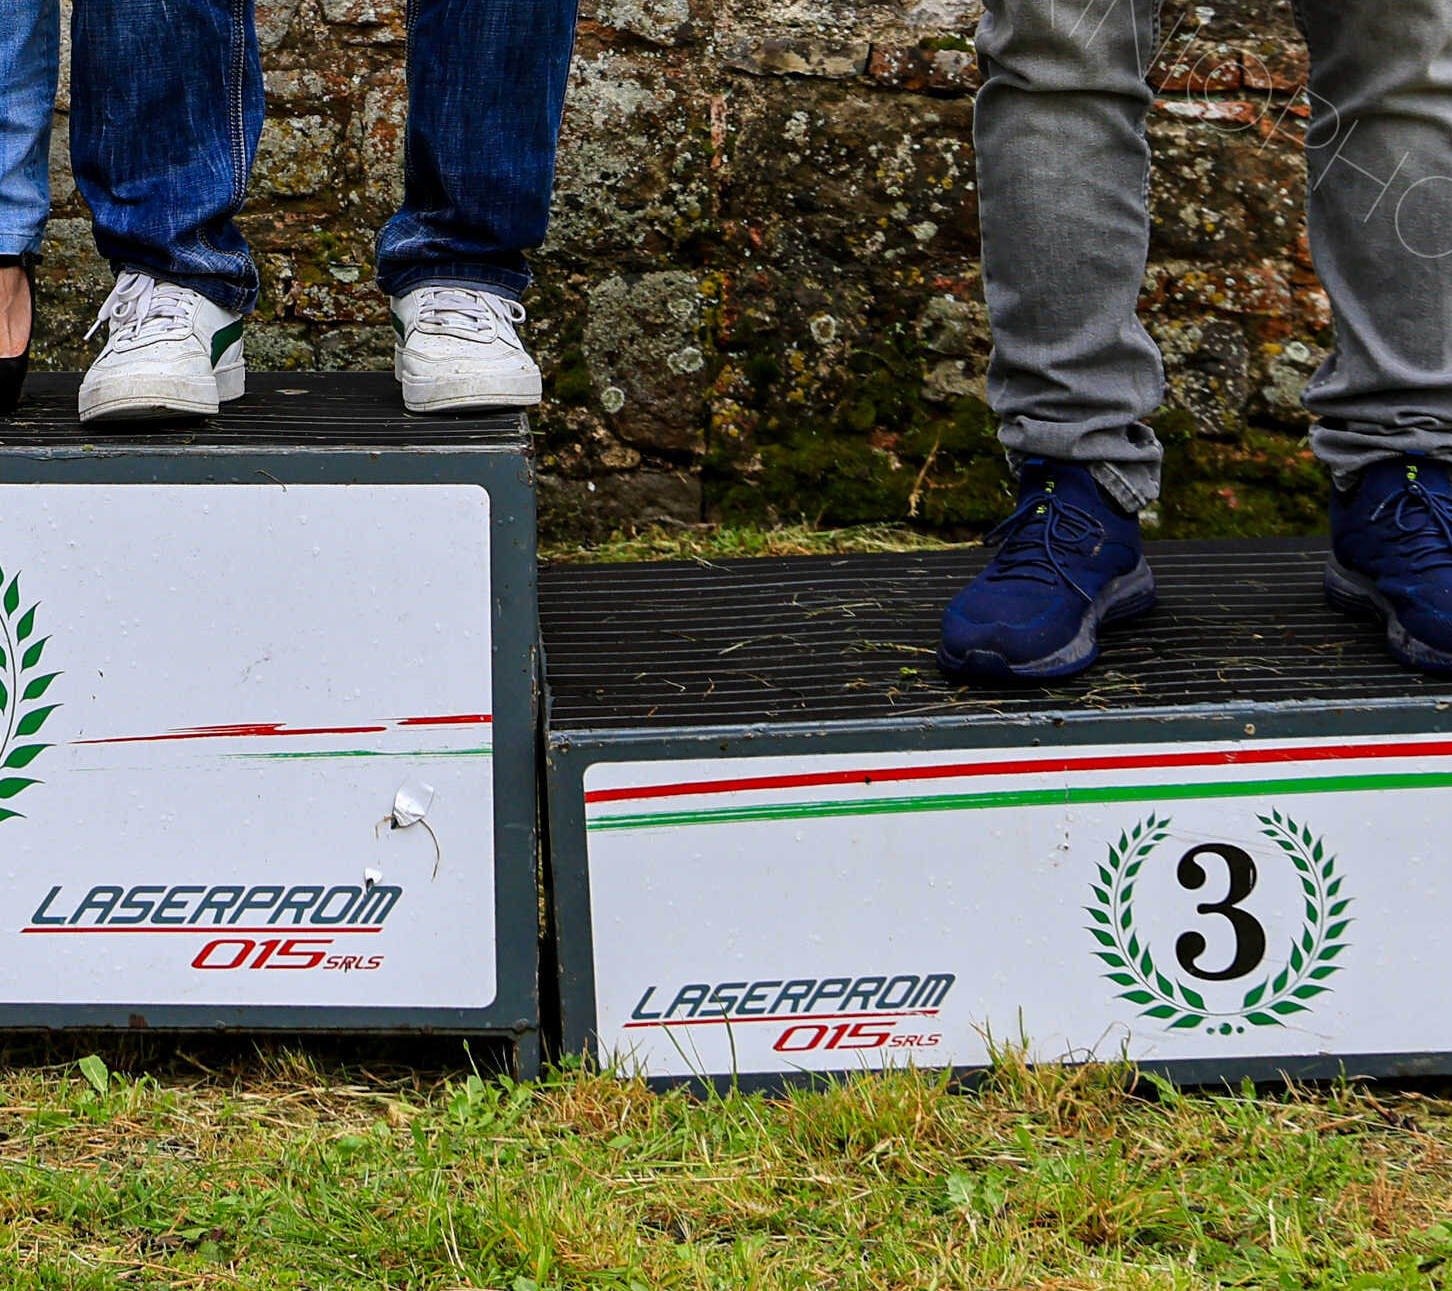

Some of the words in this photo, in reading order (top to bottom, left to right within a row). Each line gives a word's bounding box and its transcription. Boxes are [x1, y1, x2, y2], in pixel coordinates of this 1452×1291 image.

[30, 885, 403, 927] LASERPROM
[1175, 842, 1266, 983] 3
[323, 954, 385, 971] SRLS
[635, 973, 956, 1017] LASERPROM
[889, 1033, 943, 1049] SRLS
